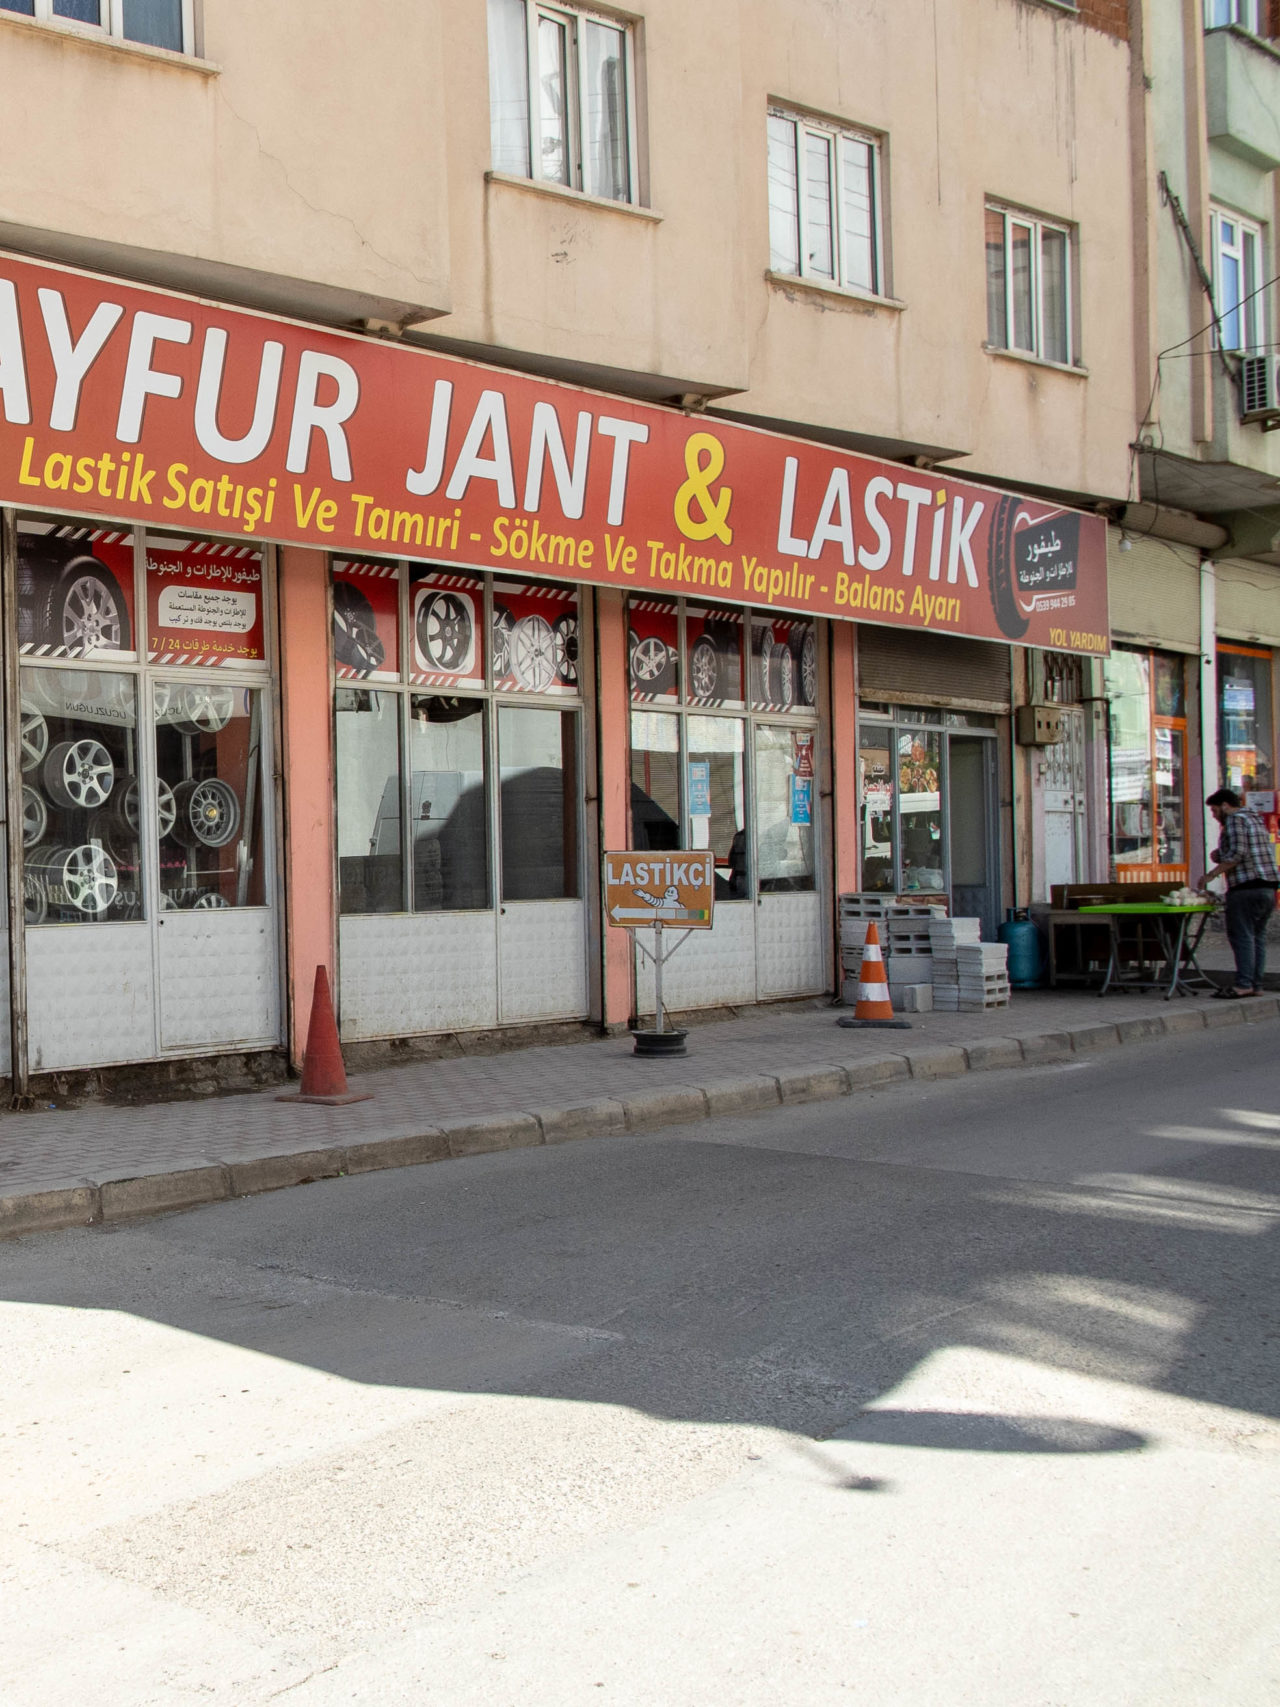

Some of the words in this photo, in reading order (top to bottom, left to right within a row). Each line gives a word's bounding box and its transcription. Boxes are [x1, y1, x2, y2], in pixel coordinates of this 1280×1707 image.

[406, 379, 649, 526] JANT
[674, 432, 733, 546] &
[18, 436, 156, 504] Lastik
[162, 462, 277, 532] Satışi
[293, 483, 338, 534] Ve
[351, 493, 462, 550] Tamıri
[490, 516, 594, 568] Sökme
[604, 533, 638, 575] Ve
[646, 540, 733, 588] Takma
[741, 555, 815, 603] Yapılır
[834, 571, 905, 615] Balans
[909, 585, 961, 626] Ayarı
[1026, 530, 1061, 562] طيفور
[185, 565, 192, 577] و
[232, 568, 260, 583] طيفور
[212, 641, 235, 653] خدمة
[1050, 627, 1068, 646] YOL
[1070, 629, 1107, 652] YARDIM
[237, 647, 258, 658] يوجد
[607, 857, 711, 891] LASTİKÇİ
